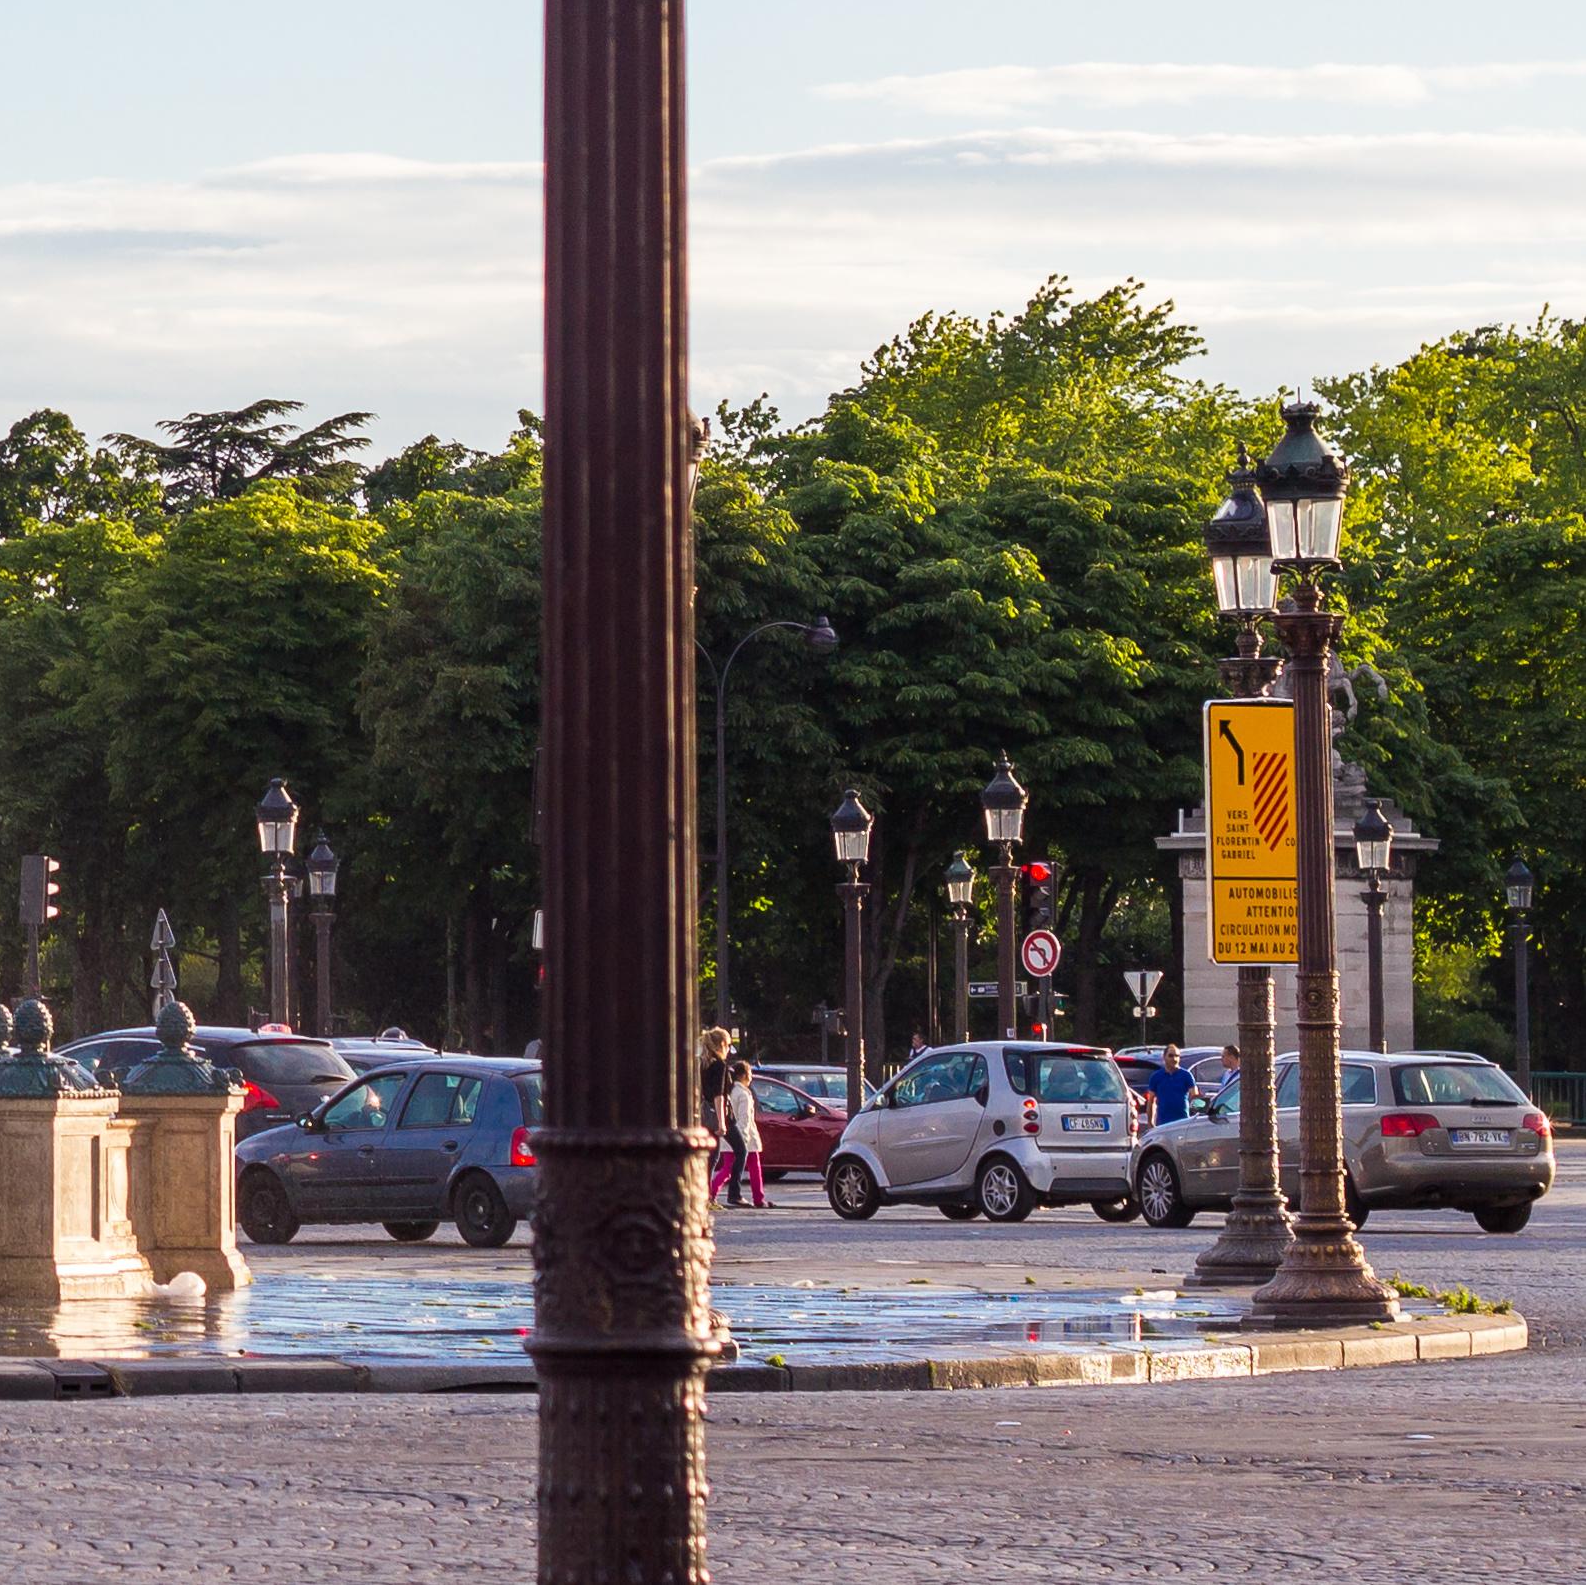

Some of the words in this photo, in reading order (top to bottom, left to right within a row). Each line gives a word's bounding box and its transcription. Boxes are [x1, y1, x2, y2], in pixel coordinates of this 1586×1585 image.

[1227, 810, 1248, 819] VERS
[1226, 823, 1249, 832] SAINT
[1216, 836, 1260, 846] FLORENTIN
[1221, 850, 1256, 859] GABRIEL
[1220, 924, 1280, 935] CIRCULATION
[1218, 942, 1231, 954] DU
[1235, 942, 1246, 954] 12
[1250, 942, 1269, 954] MAI
[1272, 942, 1286, 954] AU
